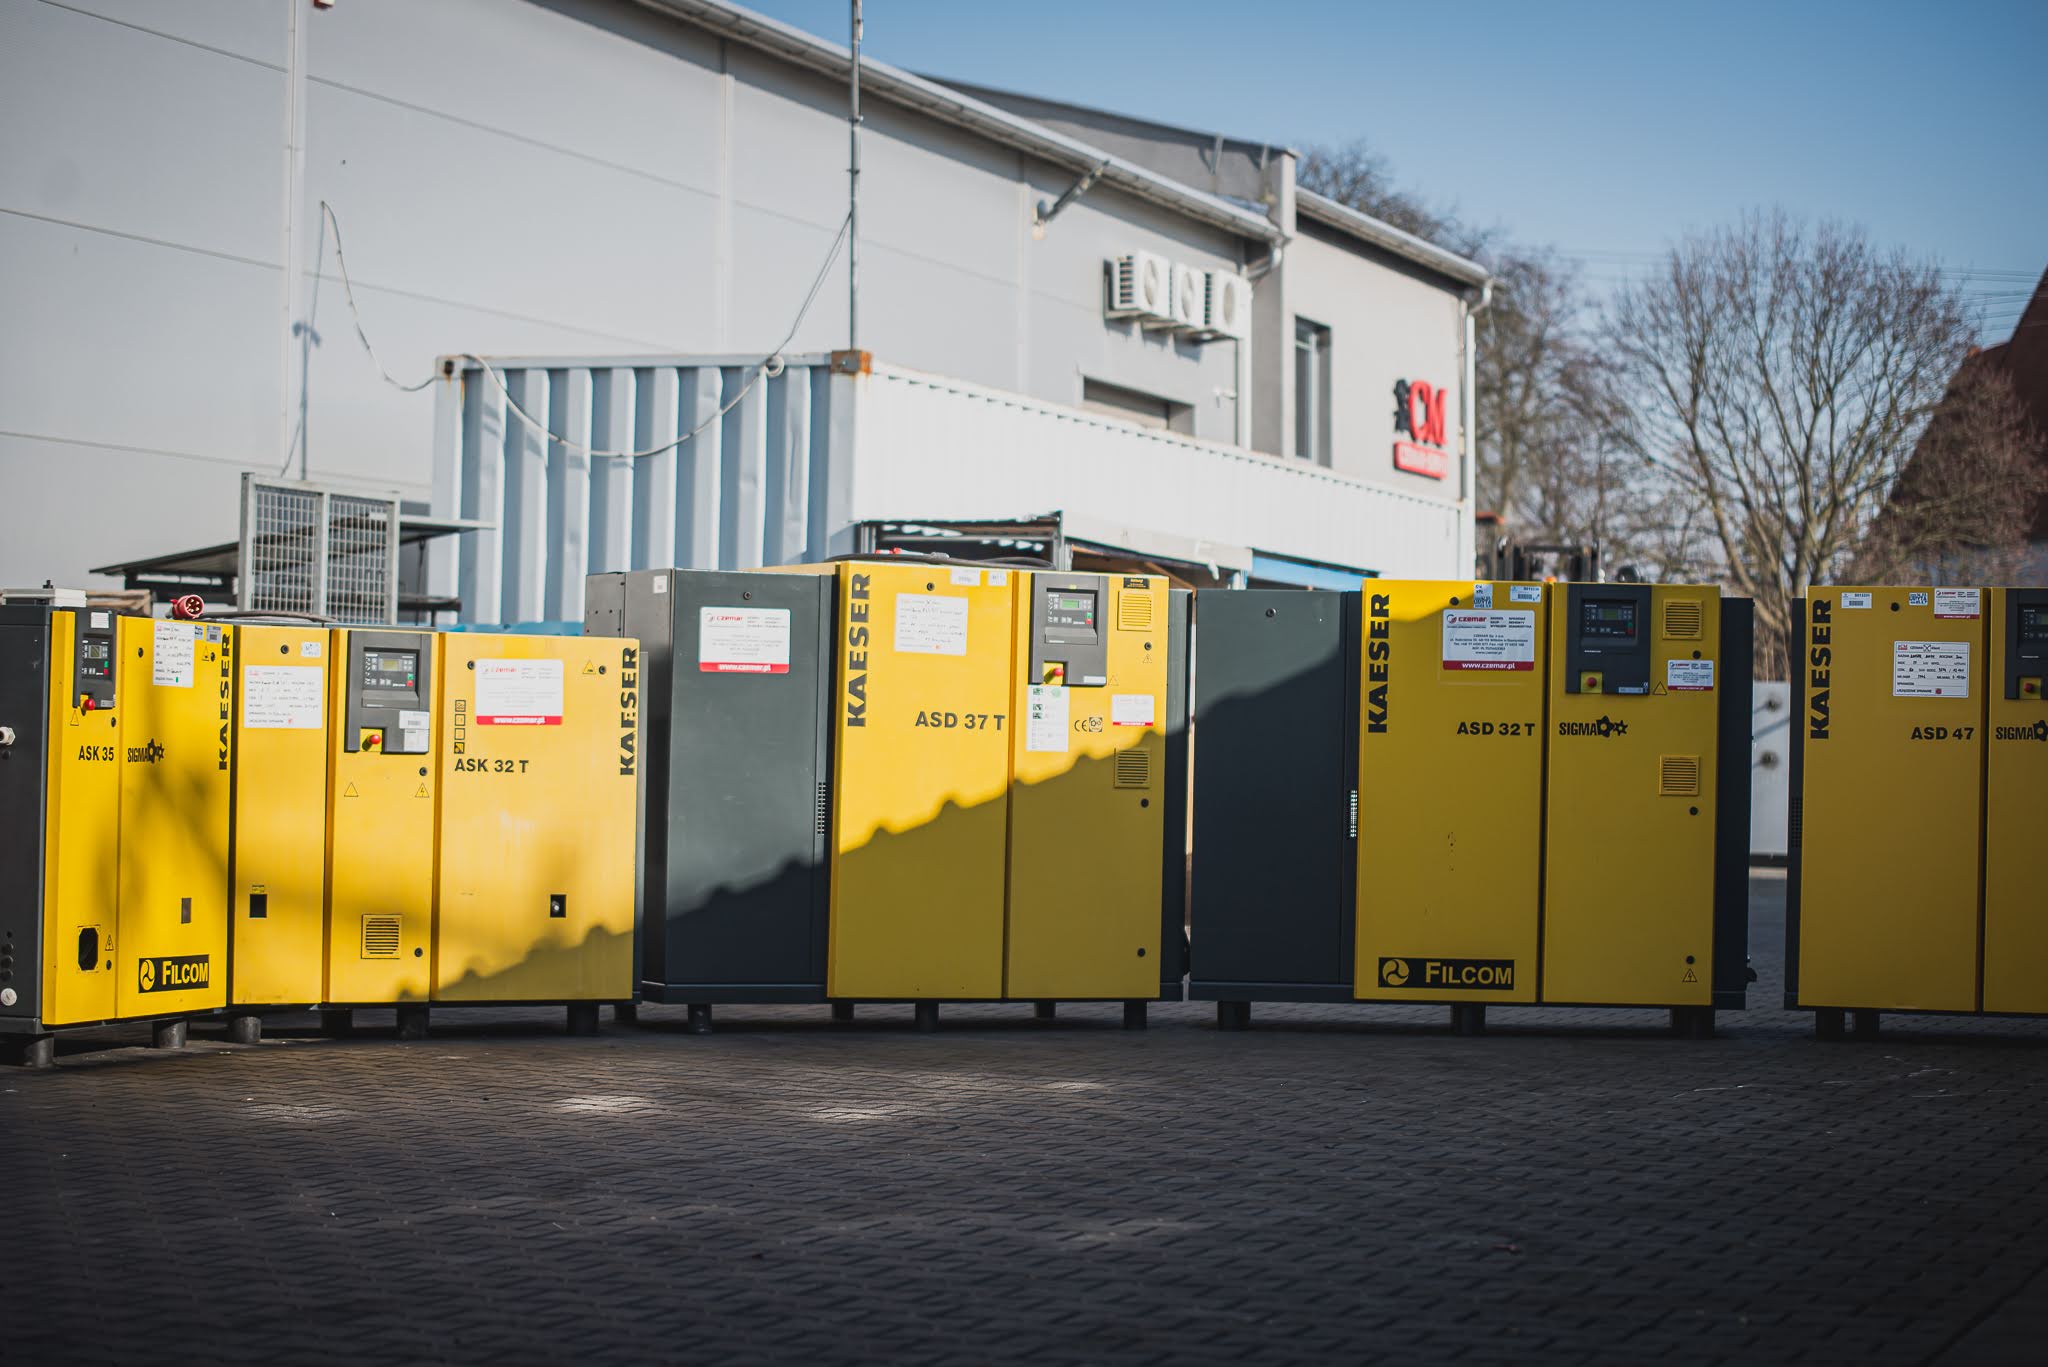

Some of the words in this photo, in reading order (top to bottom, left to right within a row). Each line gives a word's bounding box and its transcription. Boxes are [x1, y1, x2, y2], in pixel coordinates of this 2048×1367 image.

[847, 573, 871, 728] KAESER
[1368, 593, 1390, 734] KAESER
[1462, 662, 1516, 670] www.czemar.pl
[1811, 599, 1832, 740] KAESER
[219, 633, 231, 771] KAESER
[619, 647, 638, 776] KAESER
[915, 711, 958, 728] ASD
[964, 713, 986, 730] 37
[993, 715, 1006, 730] T
[1457, 721, 1495, 736] ASD
[1498, 722, 1521, 736] 32
[1525, 723, 1535, 736] T
[1559, 721, 1598, 736] SIGMA
[1911, 727, 1948, 740] ASD
[1952, 727, 1974, 740] 47
[1995, 726, 2035, 740] SIGMA
[78, 745, 100, 761] ASK
[102, 746, 114, 761] 35
[127, 747, 150, 762] SIGMA
[454, 758, 488, 772] ASK
[494, 759, 514, 773] 32
[519, 760, 529, 773] T
